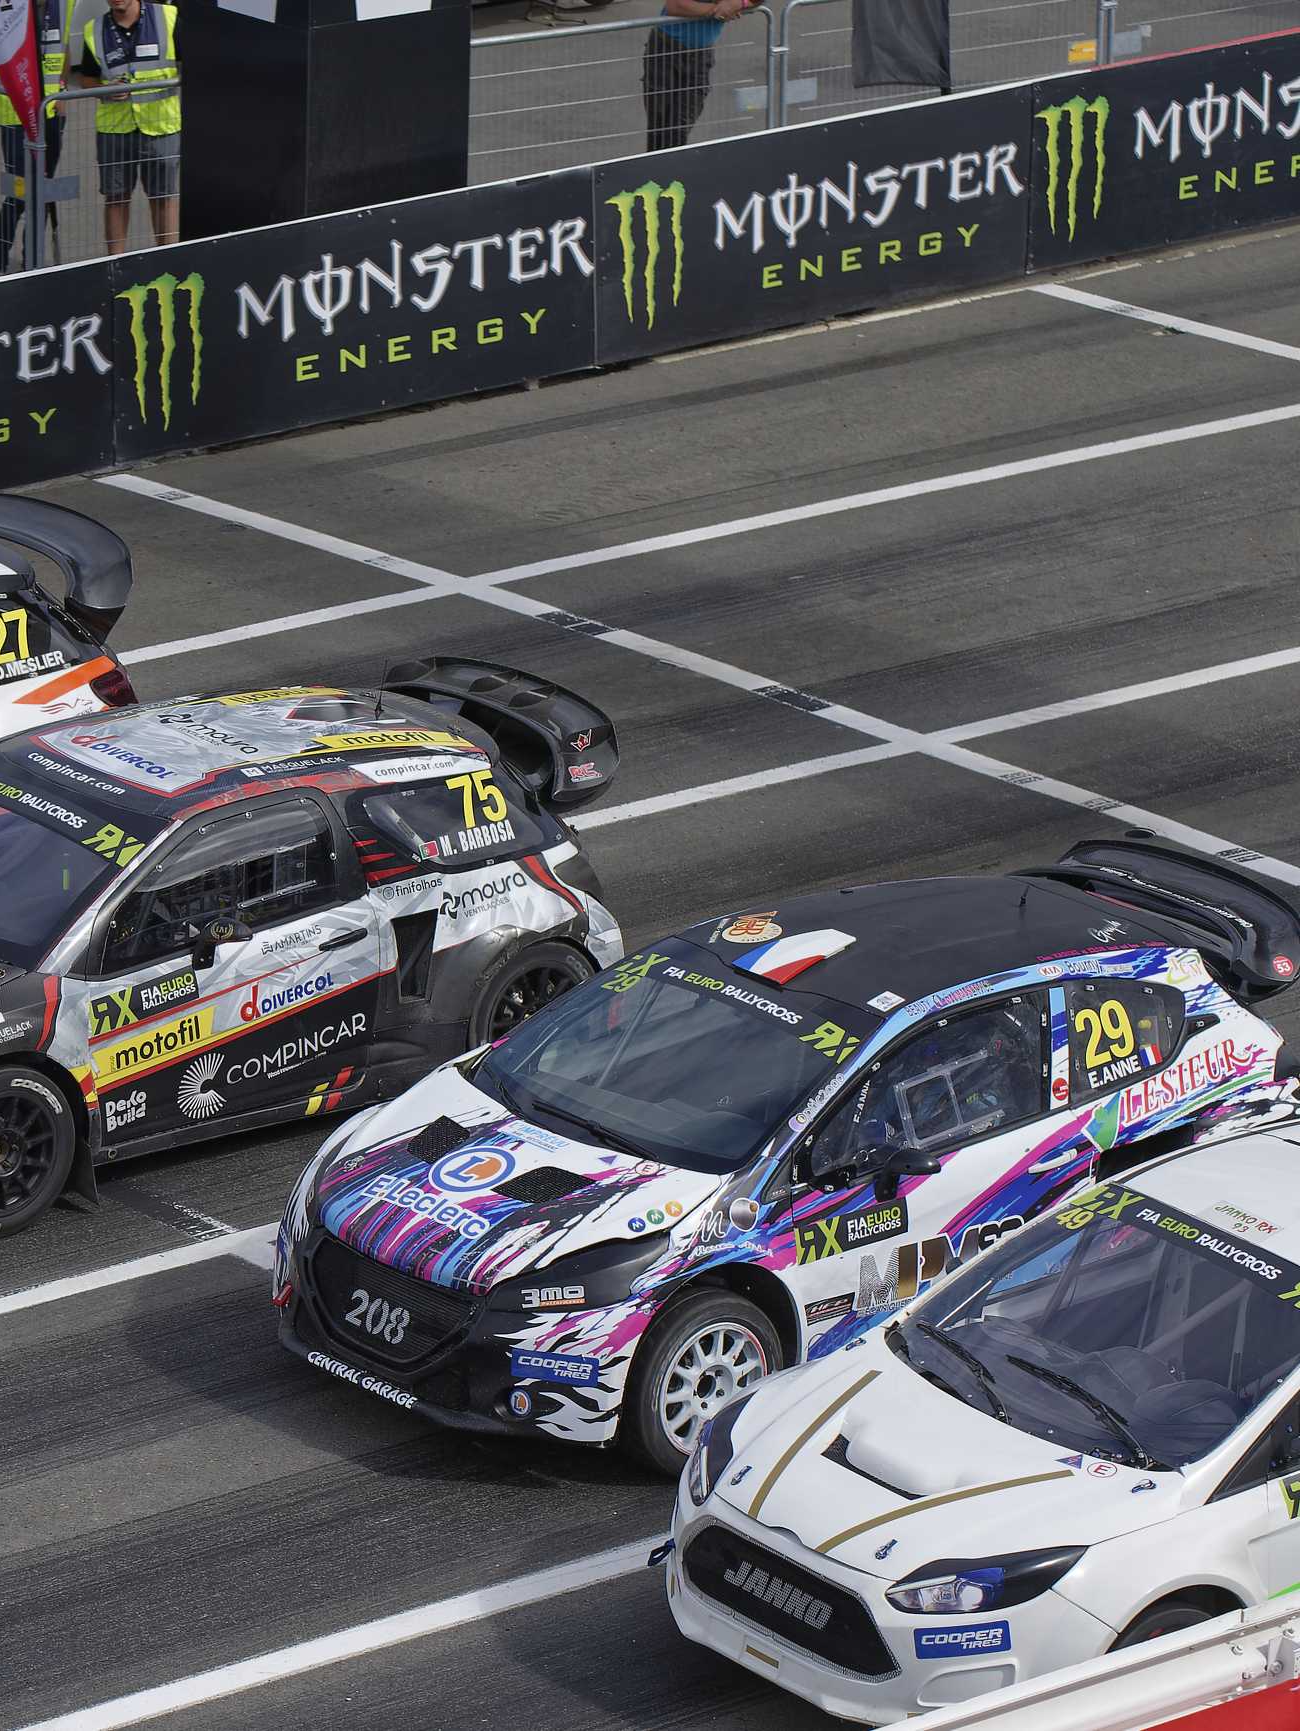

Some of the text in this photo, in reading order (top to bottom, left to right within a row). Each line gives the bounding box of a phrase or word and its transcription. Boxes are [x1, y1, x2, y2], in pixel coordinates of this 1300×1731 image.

[712, 142, 1026, 254] MONSTER
[762, 223, 980, 289] ENERGY
[235, 216, 595, 342] MONSTER
[296, 308, 547, 382] ENERGY
[186, 723, 260, 754] moura
[342, 731, 436, 746] motofil
[27, 750, 127, 796] compincar.com
[90, 740, 176, 780] DIVERCOL
[260, 756, 347, 774] MASQUELACK
[374, 760, 455, 778] compincar.com
[446, 770, 508, 830] 75
[20, 793, 87, 831] RALLYCROSS
[82, 823, 148, 867] RX
[439, 819, 516, 857] M. BARBOSA
[395, 878, 443, 897] finifolhas
[462, 871, 528, 908] moura
[601, 973, 642, 993] 29
[1041, 965, 1061, 976] KIA
[90, 984, 140, 1036] RX
[142, 984, 197, 1011] RALLYCROSS
[261, 972, 335, 1014] DIVERCOL
[662, 966, 687, 980] FIA
[683, 972, 725, 991] EURO
[721, 985, 804, 1025] RALLYCROSS
[799, 1020, 861, 1065] RX
[1075, 999, 1136, 1069] 29
[116, 1015, 201, 1069] motofil
[226, 1012, 367, 1085] COMPINCAR
[1087, 1056, 1142, 1090] E.ANNE
[1121, 1038, 1252, 1126] LESIEUR
[10, 1078, 63, 1115] COOPER
[848, 1218, 902, 1242] RALLYCROSS
[1055, 1207, 1096, 1231] 49
[1214, 1204, 1258, 1225] JANKO
[795, 1216, 843, 1265] RX
[1136, 1208, 1164, 1225] FIA
[1157, 1216, 1200, 1240] EURO
[1195, 1233, 1283, 1280] RALLYCROSS
[343, 1288, 411, 1345] 208
[307, 1350, 418, 1410] CENTRAL GARAGE
[517, 1355, 593, 1373] COOPER
[553, 1368, 590, 1381] TIRES
[722, 1560, 836, 1631] JANKO
[921, 1628, 1004, 1646] COOPER
[960, 1638, 1002, 1650] TIRES
